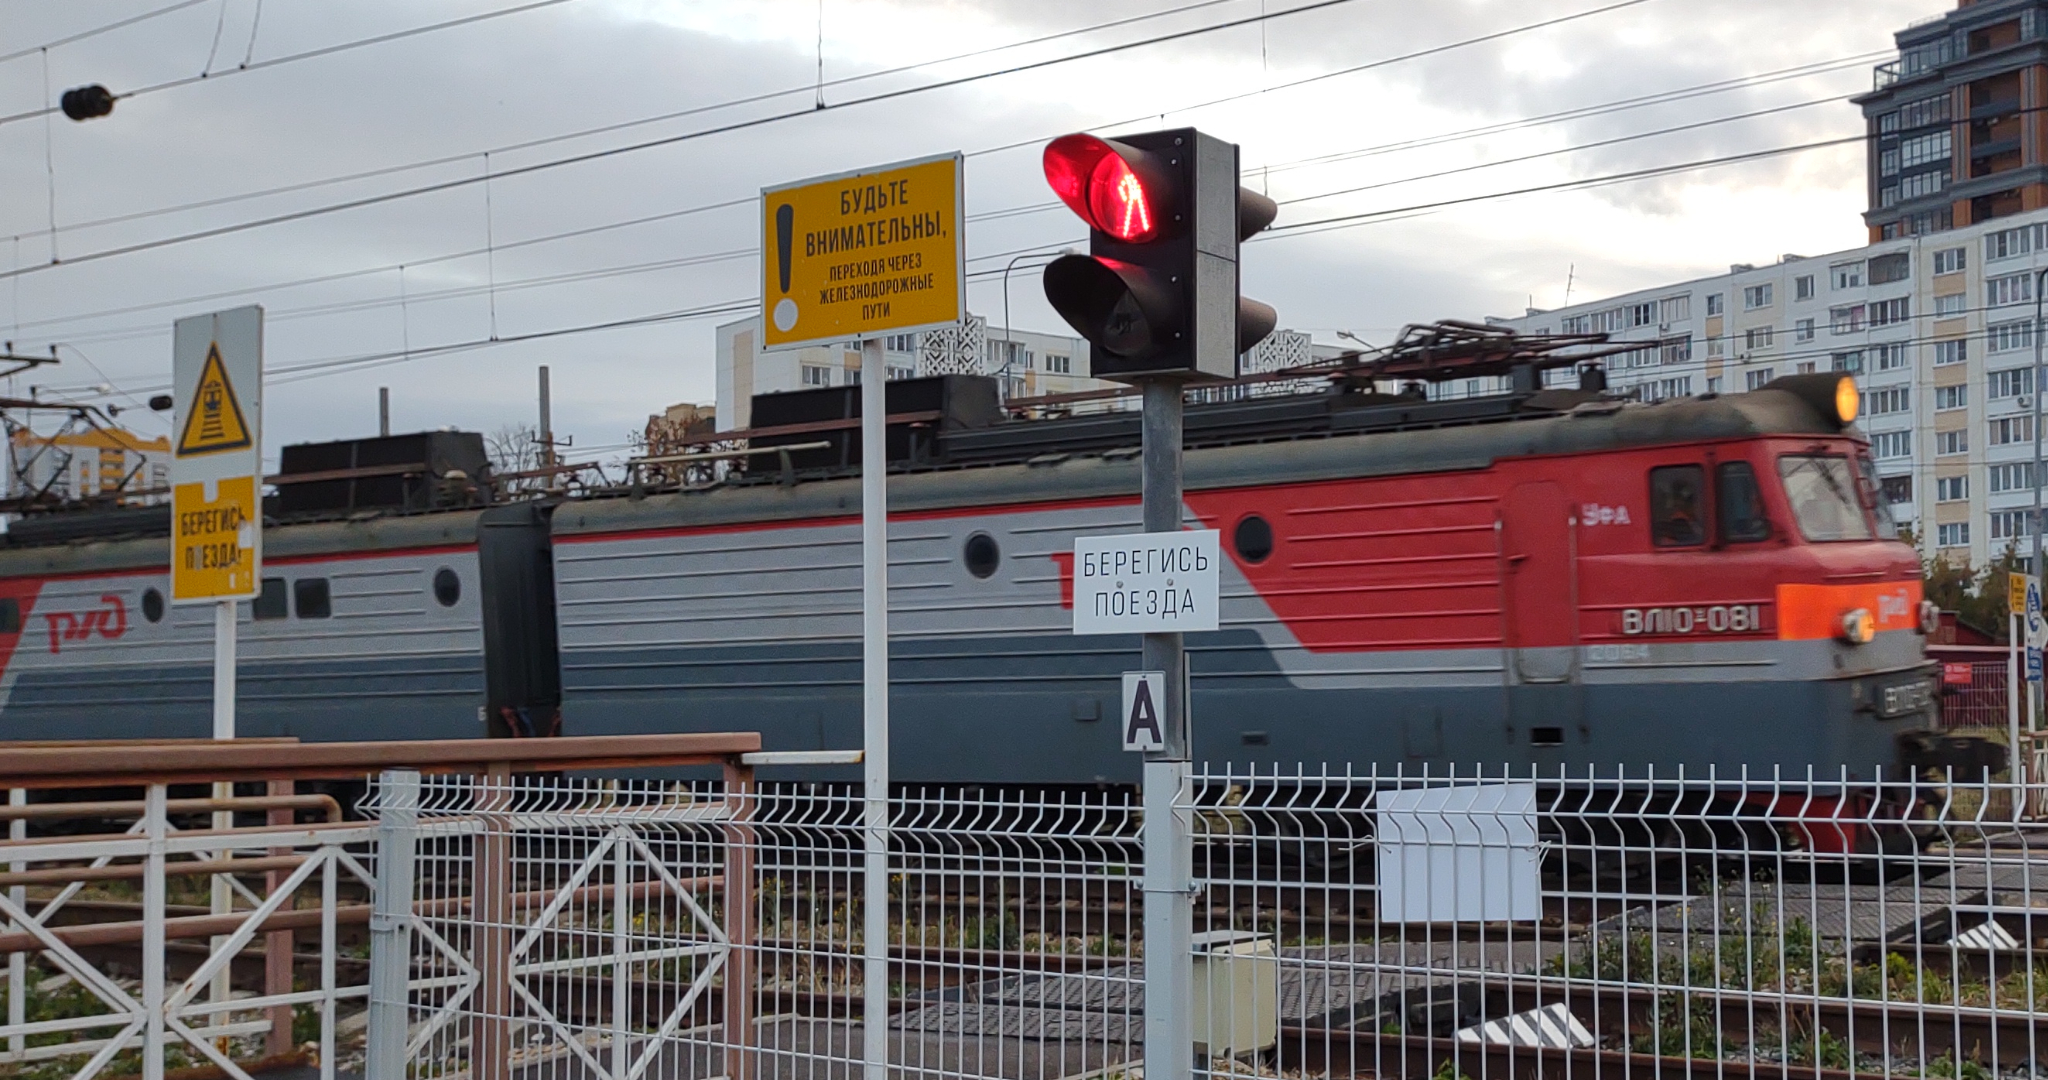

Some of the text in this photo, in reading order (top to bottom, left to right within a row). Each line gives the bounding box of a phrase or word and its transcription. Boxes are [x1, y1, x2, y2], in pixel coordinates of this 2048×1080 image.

[840, 179, 908, 215] БУДЬТЕ
[806, 211, 947, 257] ВНИМАТЕЛЬНЫ,
[829, 252, 922, 282] ПЕРЕХОДЯ ЧЕРЕЗ
[819, 273, 934, 305] ЖЕЛЕЗНОДОРОЖНЫЕ
[862, 302, 891, 320] ПУТИ
[1084, 546, 1208, 577] БЕРЕГИСЬ
[1095, 588, 1195, 620] ПОЕЗДА
[1126, 680, 1162, 744] А
